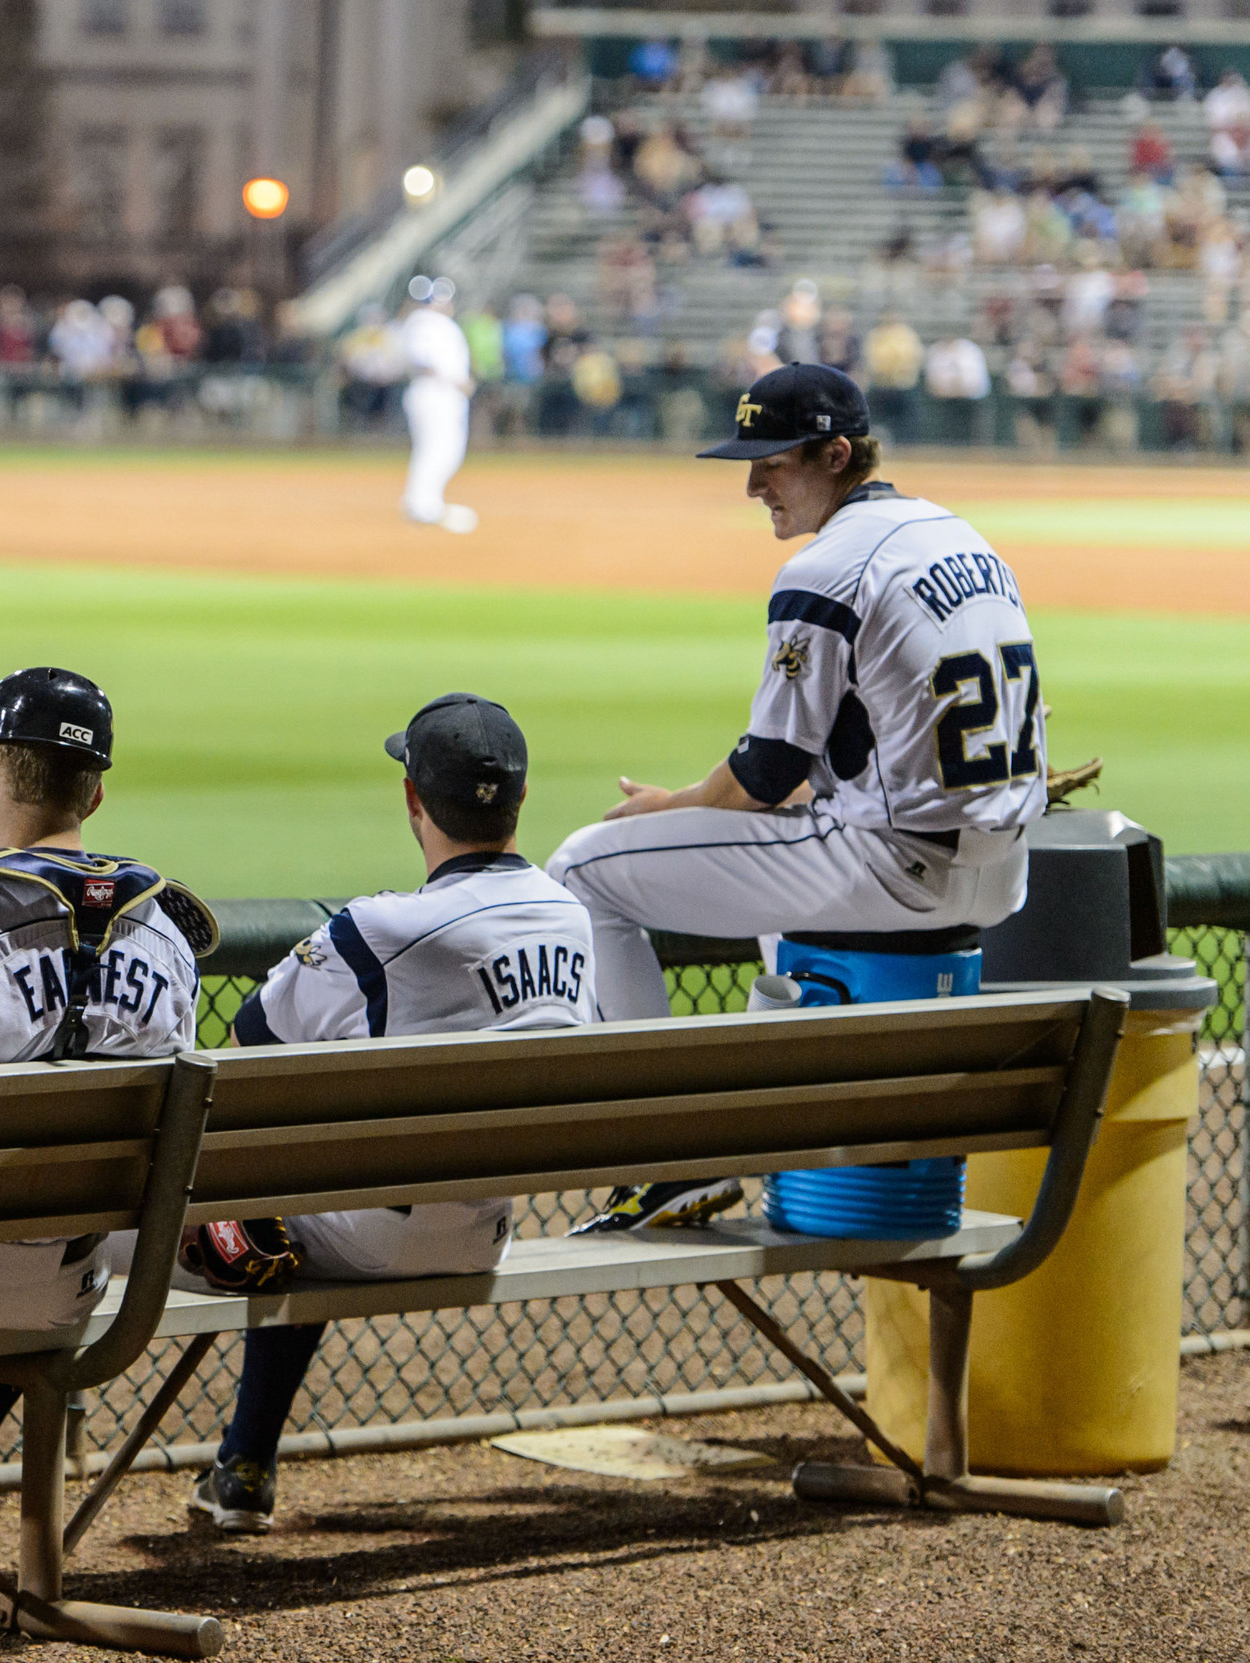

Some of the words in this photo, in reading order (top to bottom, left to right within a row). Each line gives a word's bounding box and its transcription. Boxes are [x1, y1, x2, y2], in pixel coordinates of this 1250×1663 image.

[62, 727, 90, 742] ACC
[930, 640, 1040, 791] 27
[13, 949, 169, 1025] EAEST
[477, 944, 585, 1015] ISAACS
